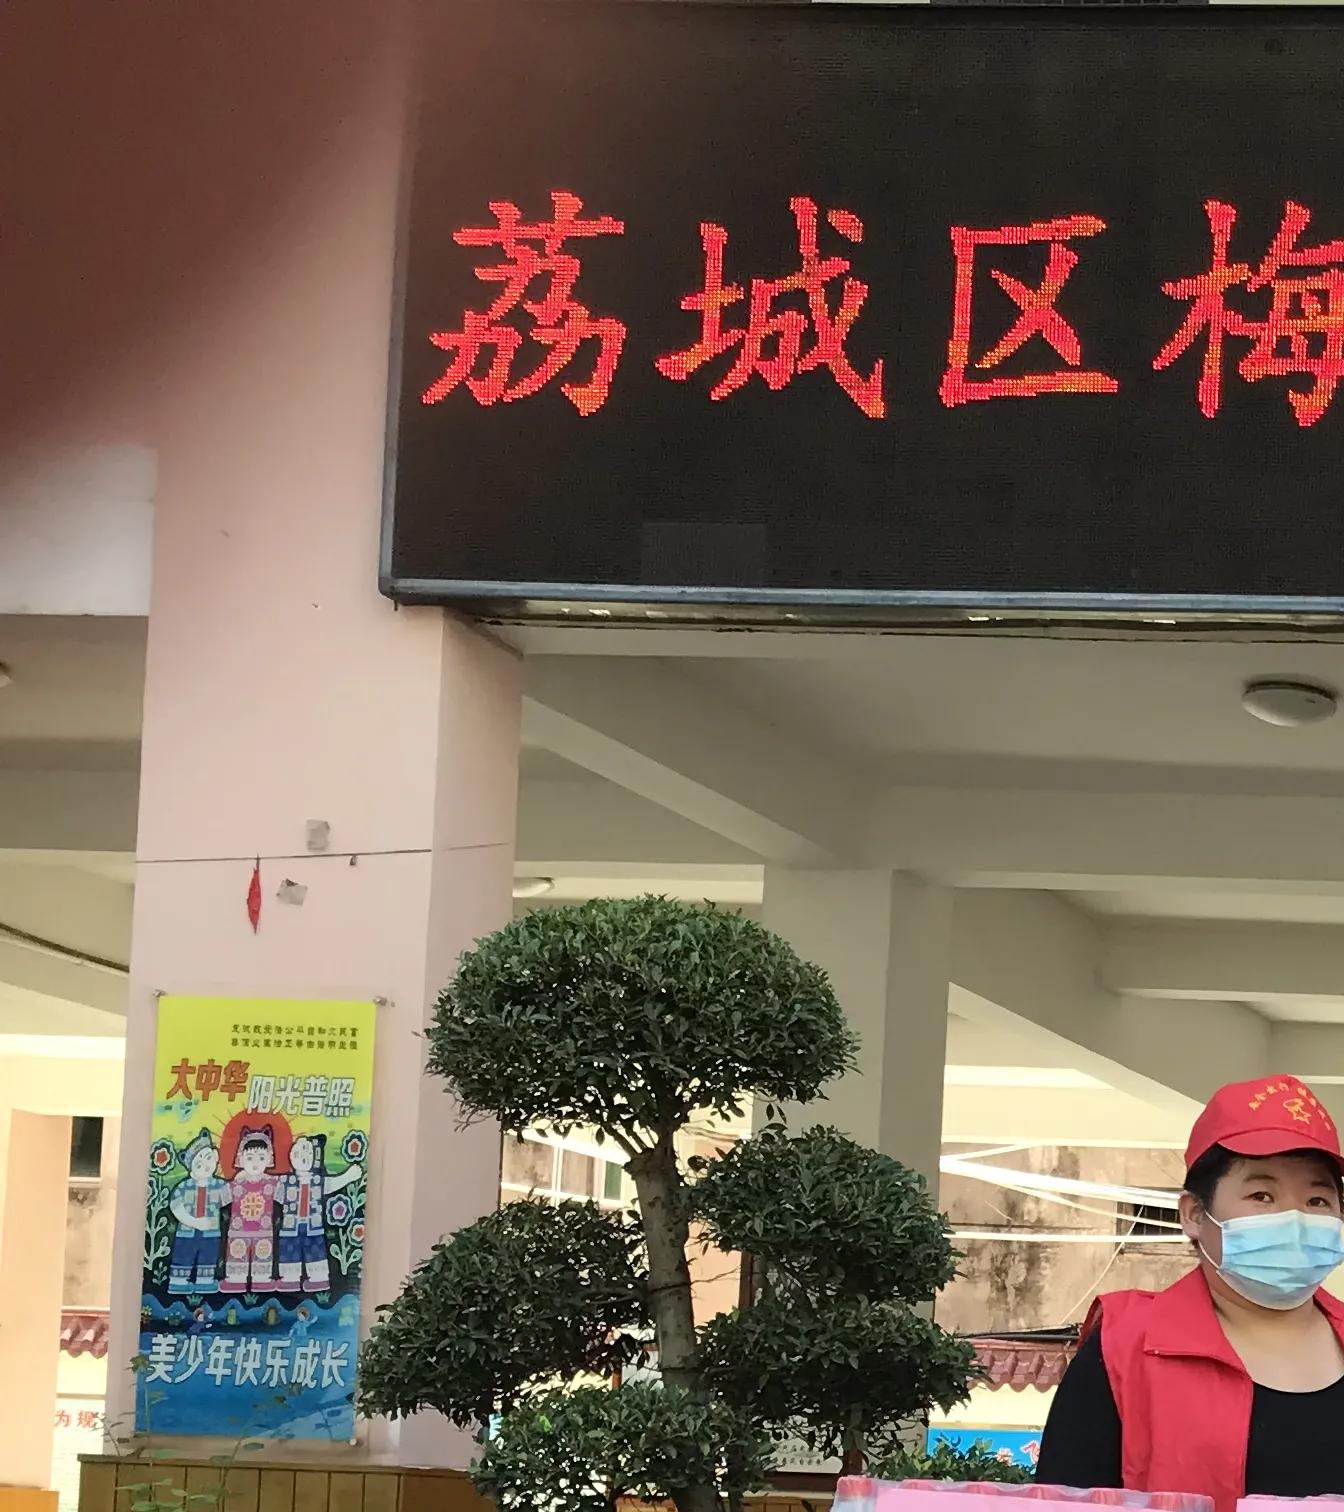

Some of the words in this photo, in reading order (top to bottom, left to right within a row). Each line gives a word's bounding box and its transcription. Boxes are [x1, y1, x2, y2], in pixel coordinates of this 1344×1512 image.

[166, 1057, 250, 1101] 大中华
[247, 1075, 355, 1118] 阳光普照
[145, 1334, 350, 1389] 美少年快乐成长
